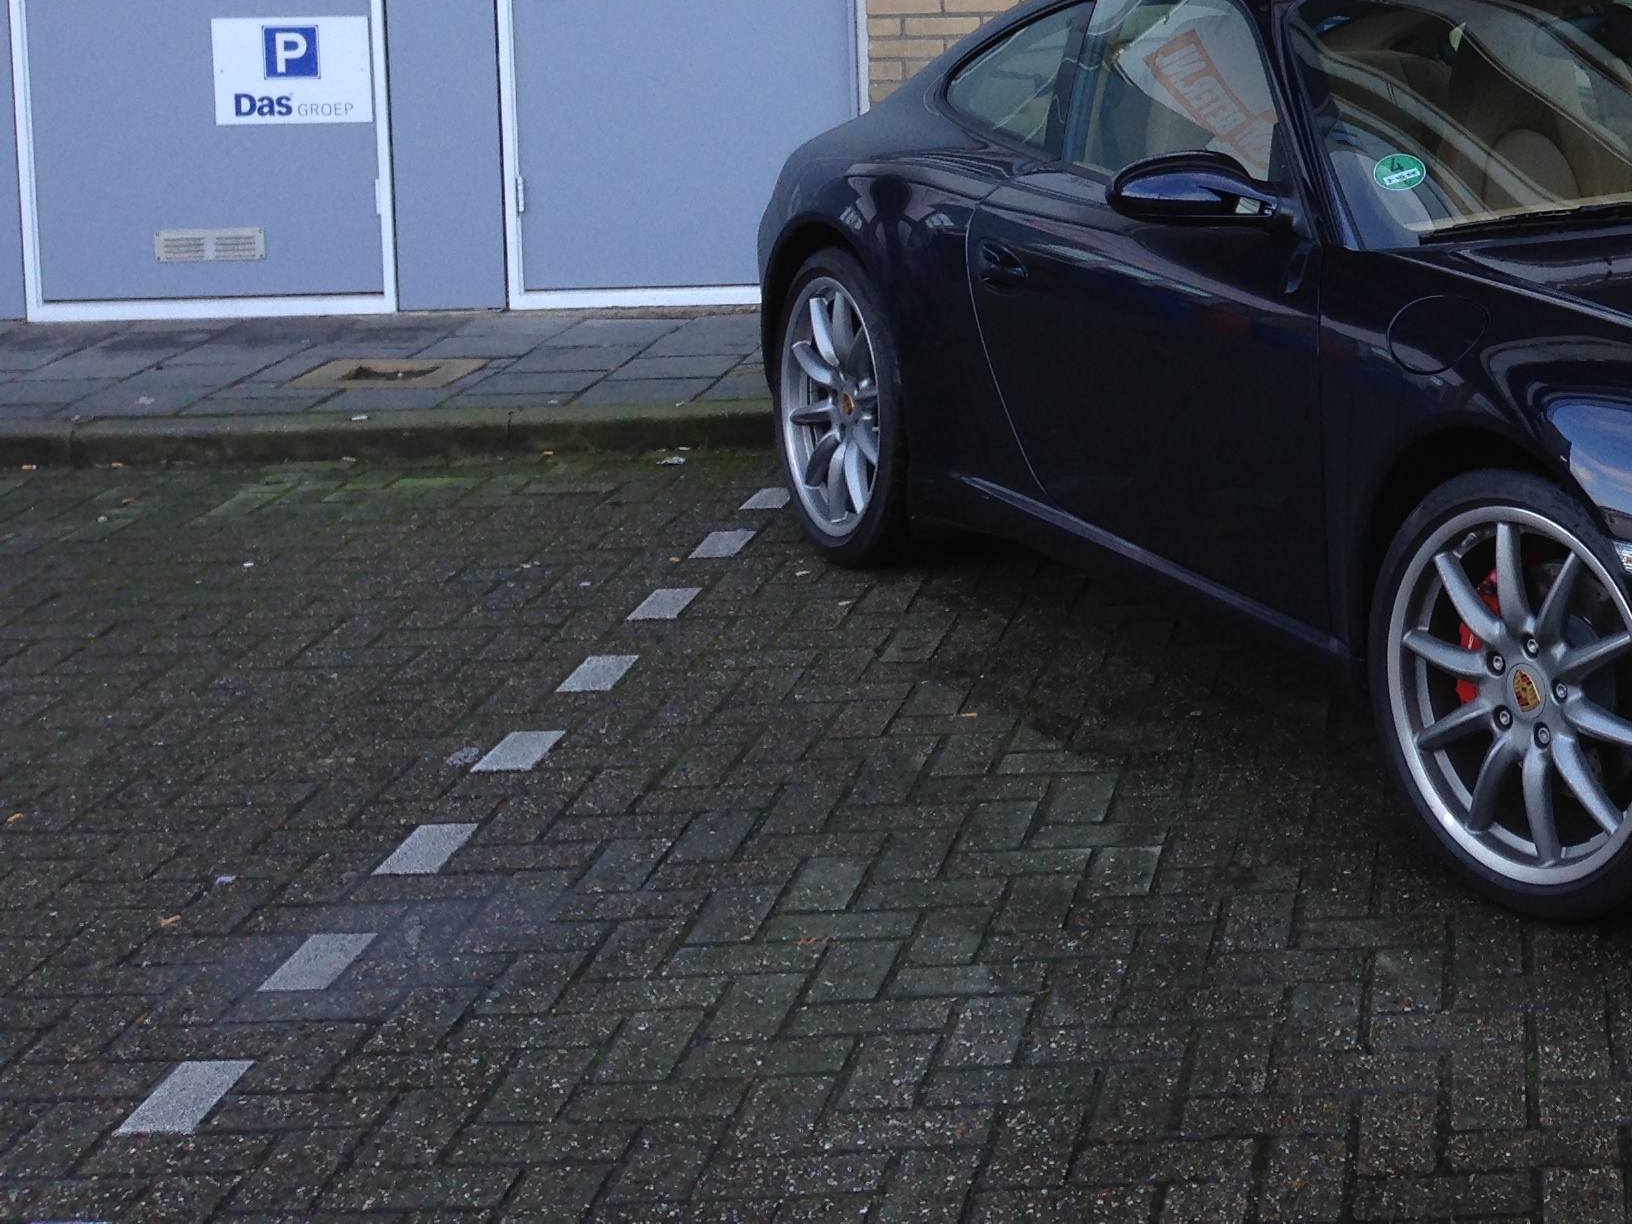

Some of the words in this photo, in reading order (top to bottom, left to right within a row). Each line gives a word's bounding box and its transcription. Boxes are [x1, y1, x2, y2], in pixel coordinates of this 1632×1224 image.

[275, 33, 307, 73] P
[234, 93, 293, 117] Das
[297, 103, 353, 117] GROEP
